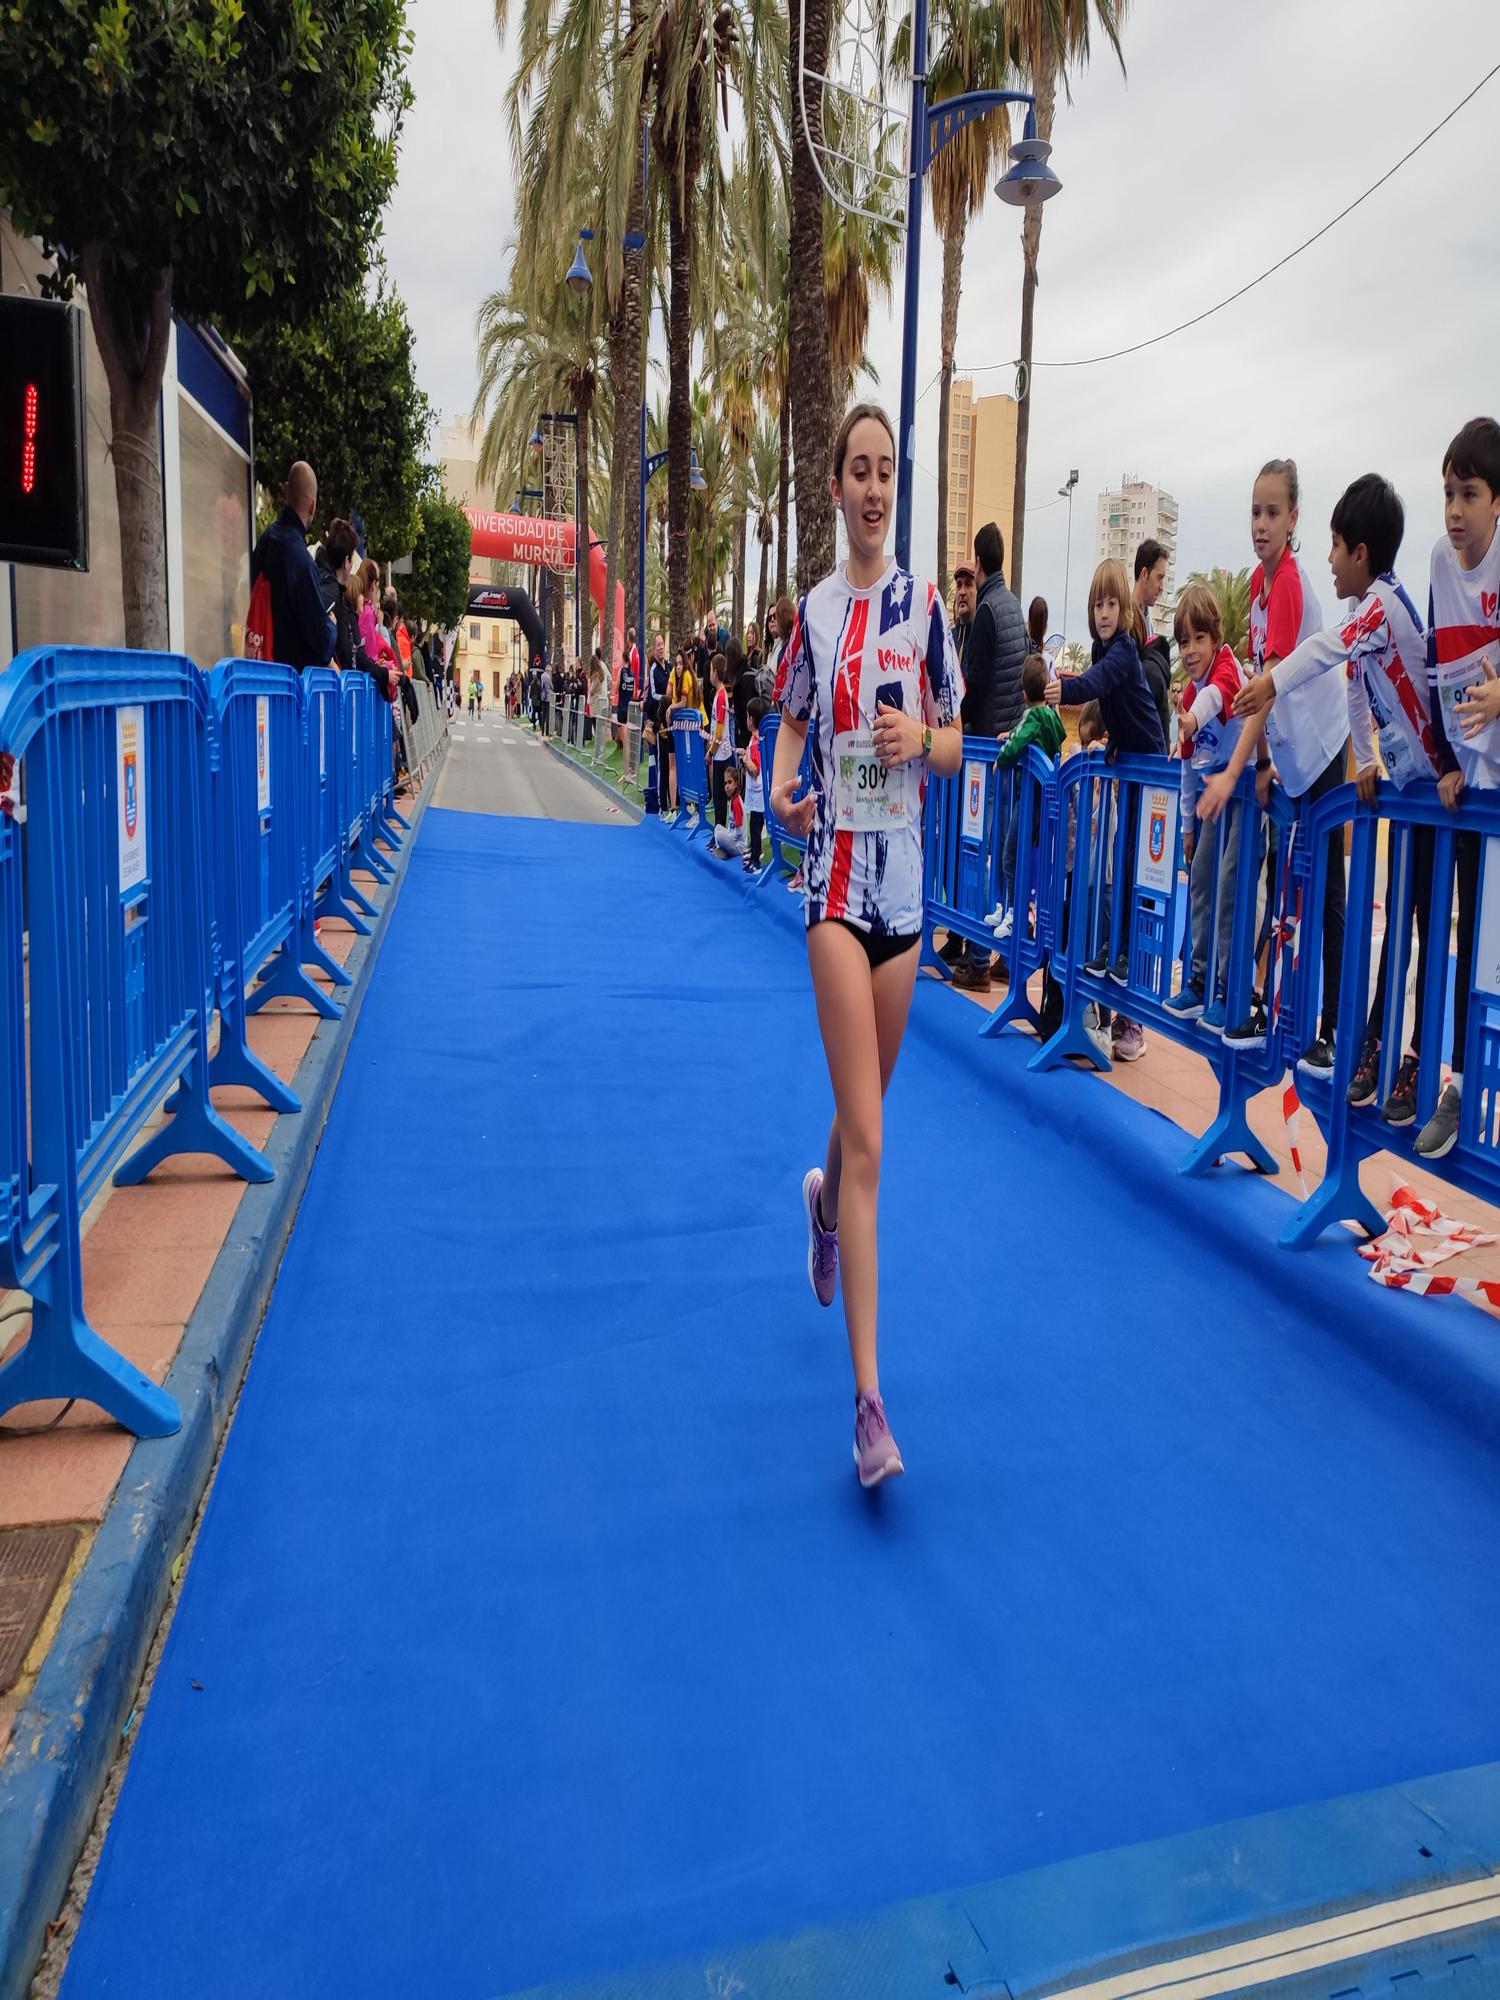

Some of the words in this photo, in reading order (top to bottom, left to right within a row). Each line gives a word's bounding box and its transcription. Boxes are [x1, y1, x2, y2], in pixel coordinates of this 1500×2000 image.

[467, 512, 544, 538] NIVERSIDAD
[548, 524, 565, 541] DE
[513, 542, 564, 563] MURCIA
[877, 647, 916, 674] Vive!
[858, 763, 888, 789] 309
